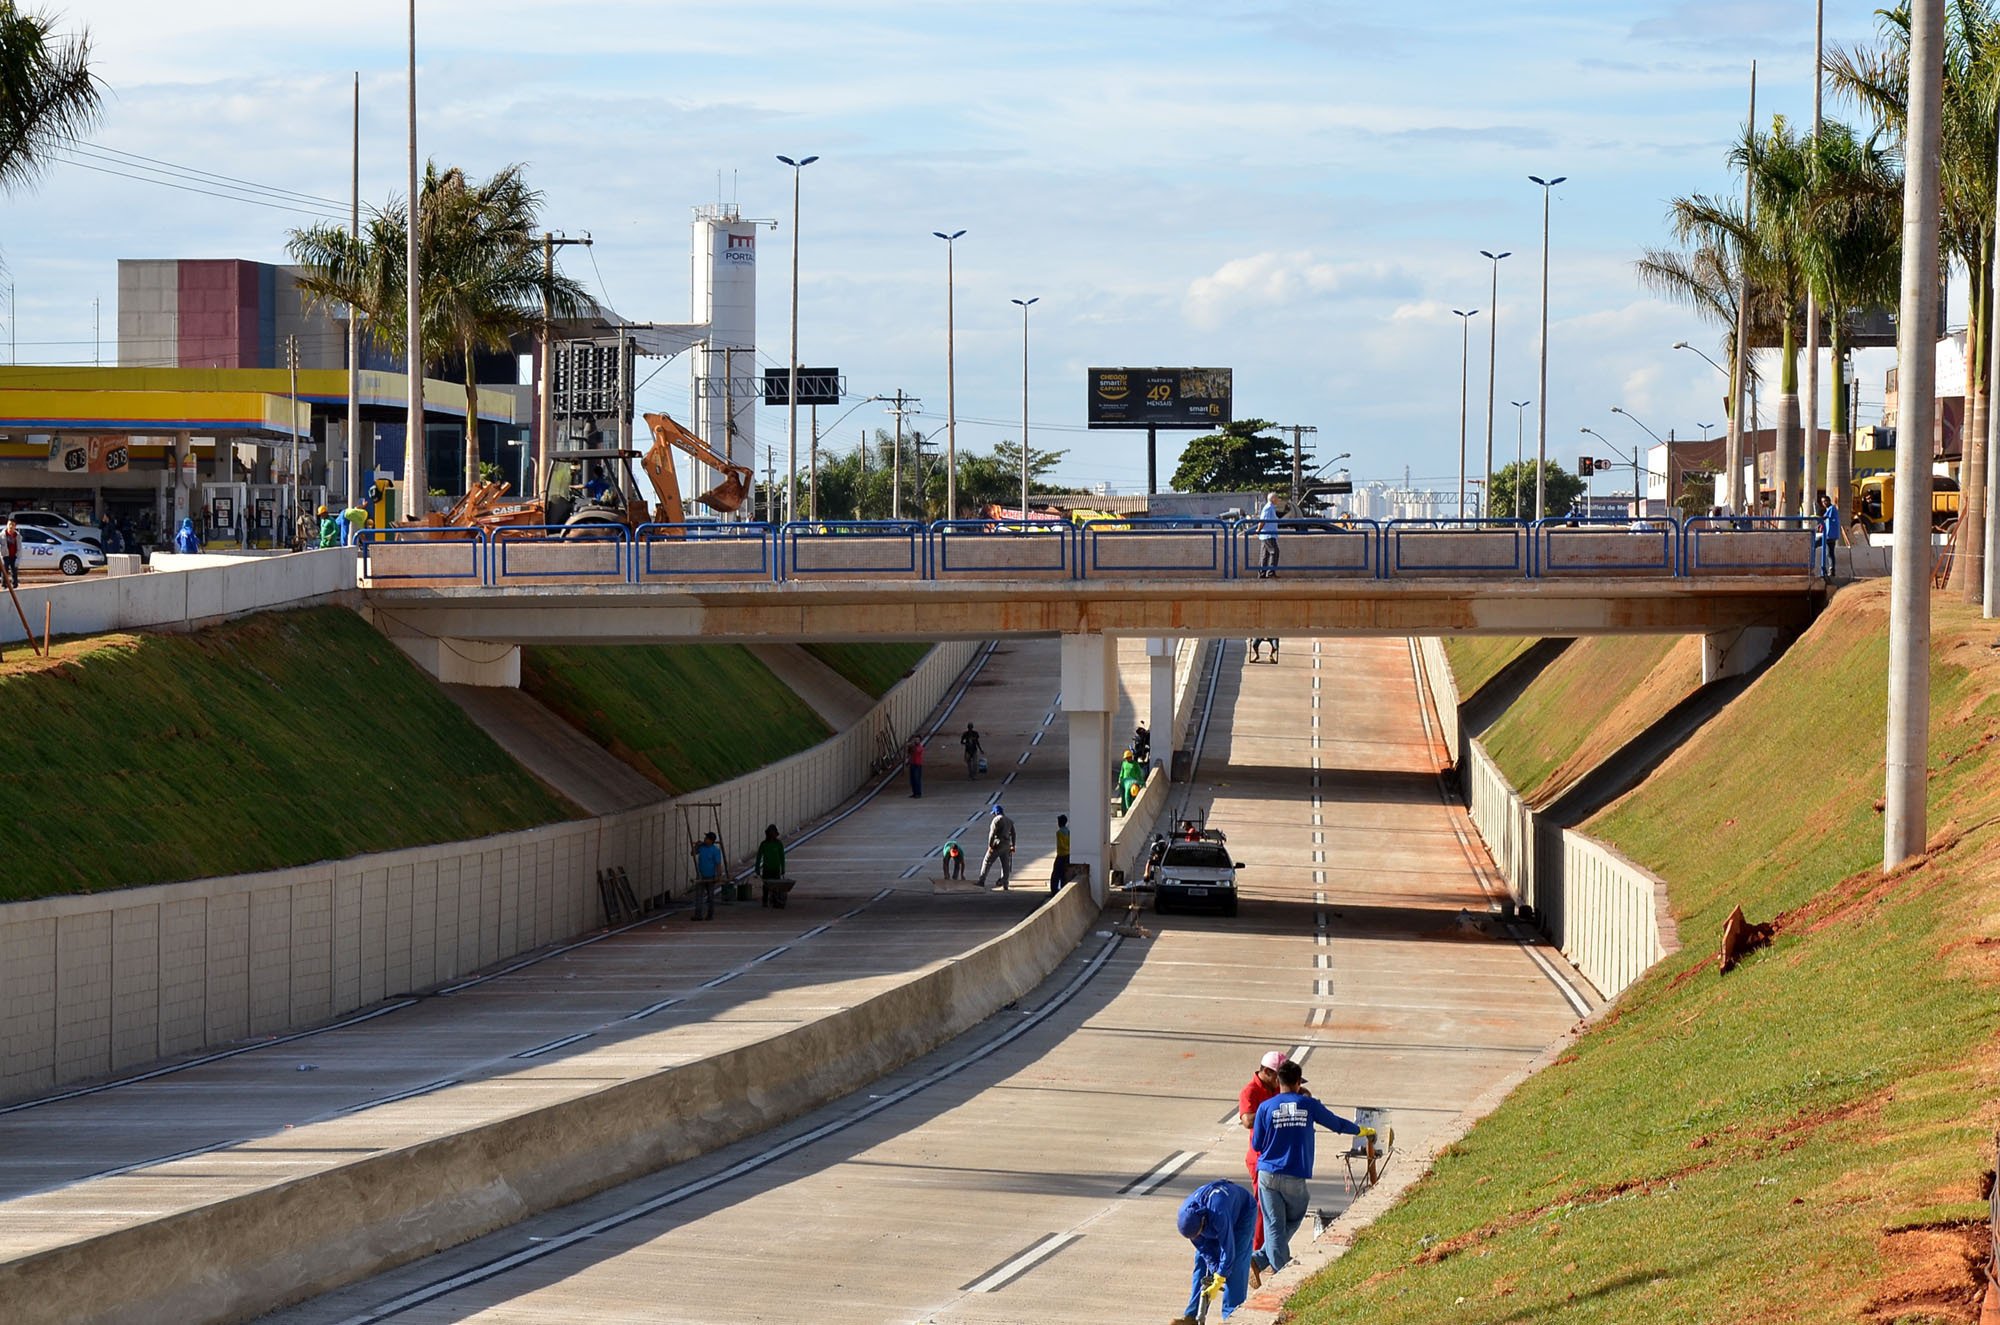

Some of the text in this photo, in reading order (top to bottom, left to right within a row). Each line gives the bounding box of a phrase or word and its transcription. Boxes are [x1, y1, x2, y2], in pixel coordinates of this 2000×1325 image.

[1147, 384, 1171, 401] 49
[492, 505, 522, 515] CASE
[31, 546, 54, 556] TBC
